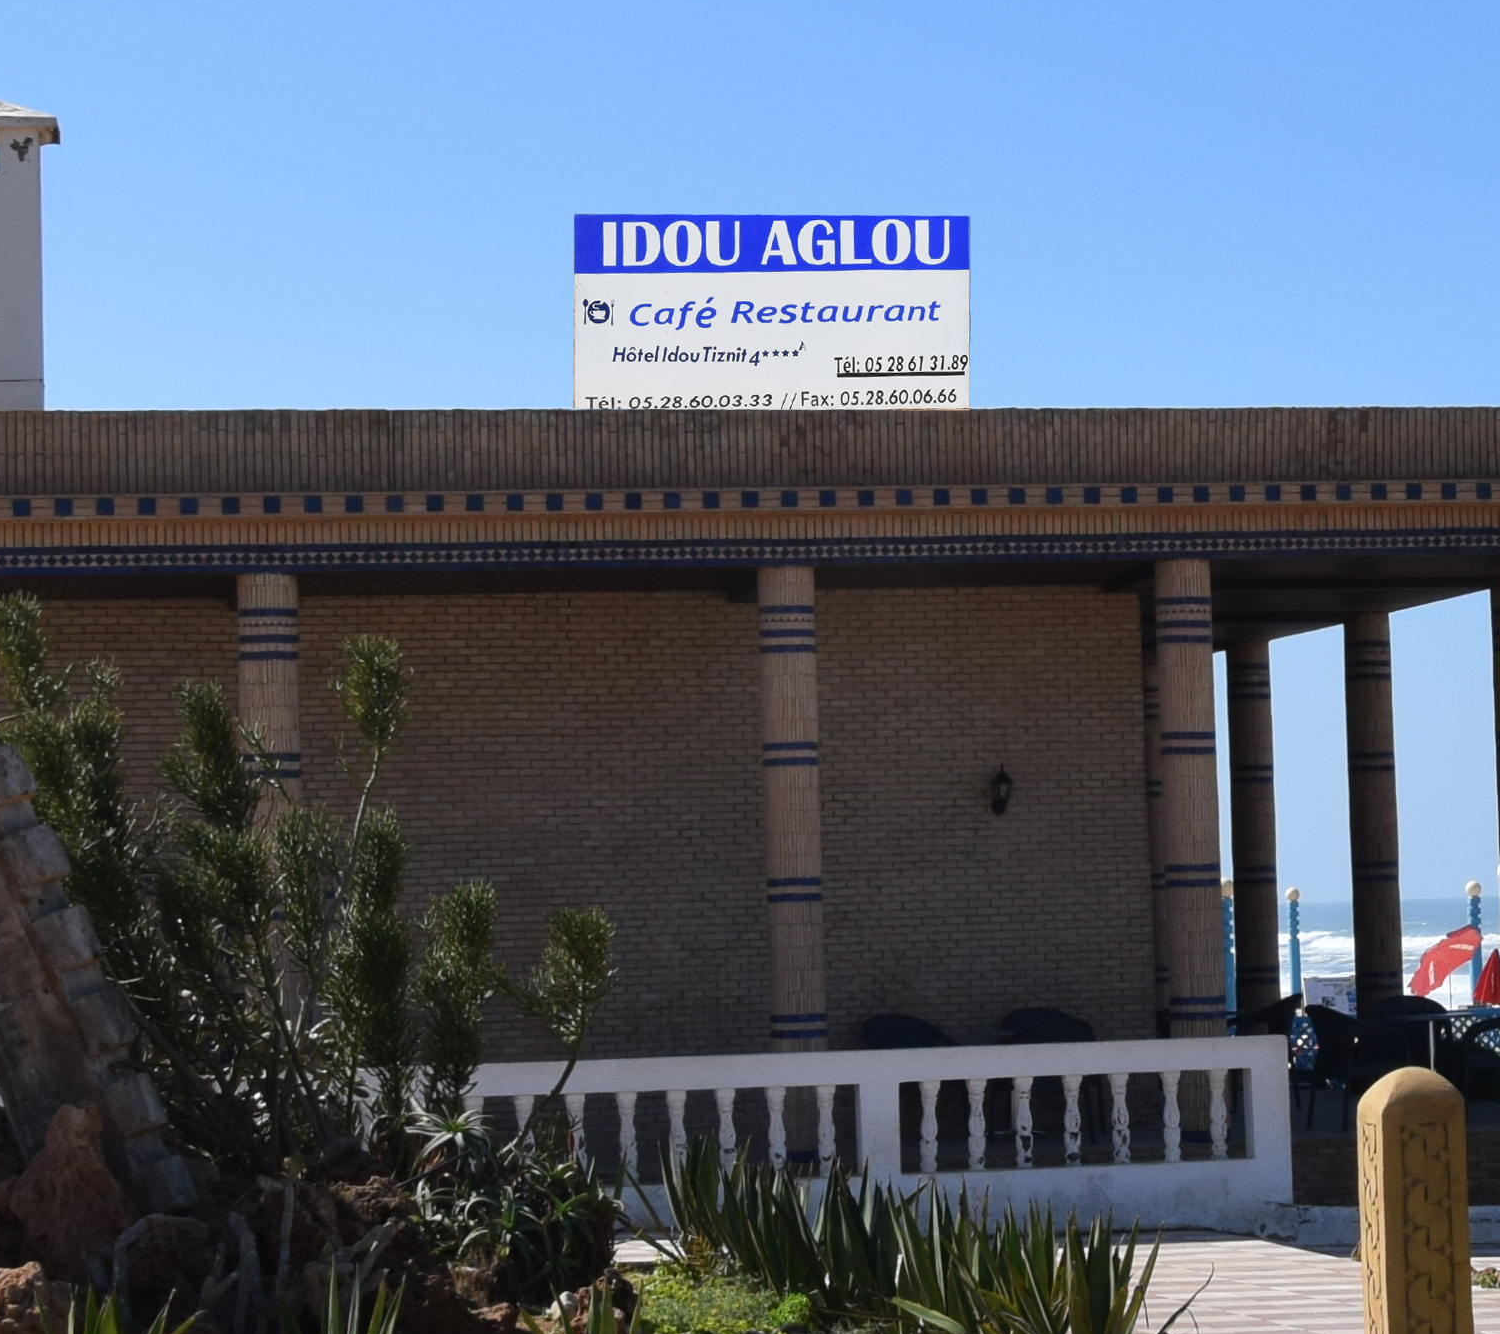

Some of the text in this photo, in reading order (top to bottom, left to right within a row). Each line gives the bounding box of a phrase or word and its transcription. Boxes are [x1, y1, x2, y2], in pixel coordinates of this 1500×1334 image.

[602, 219, 950, 267] IDOU AGLOU
[628, 297, 942, 331] Café Restaurant
[612, 345, 660, 363] Hôtel
[662, 345, 700, 363] Idou
[703, 346, 747, 363] Tiznit
[834, 354, 969, 373] Tél: 05 28 61 31.89
[585, 395, 622, 410] Tél:
[628, 393, 774, 410] 05.28.60.03.33
[800, 391, 835, 408] Fax:
[840, 388, 958, 407] 05.28.60.06.66
